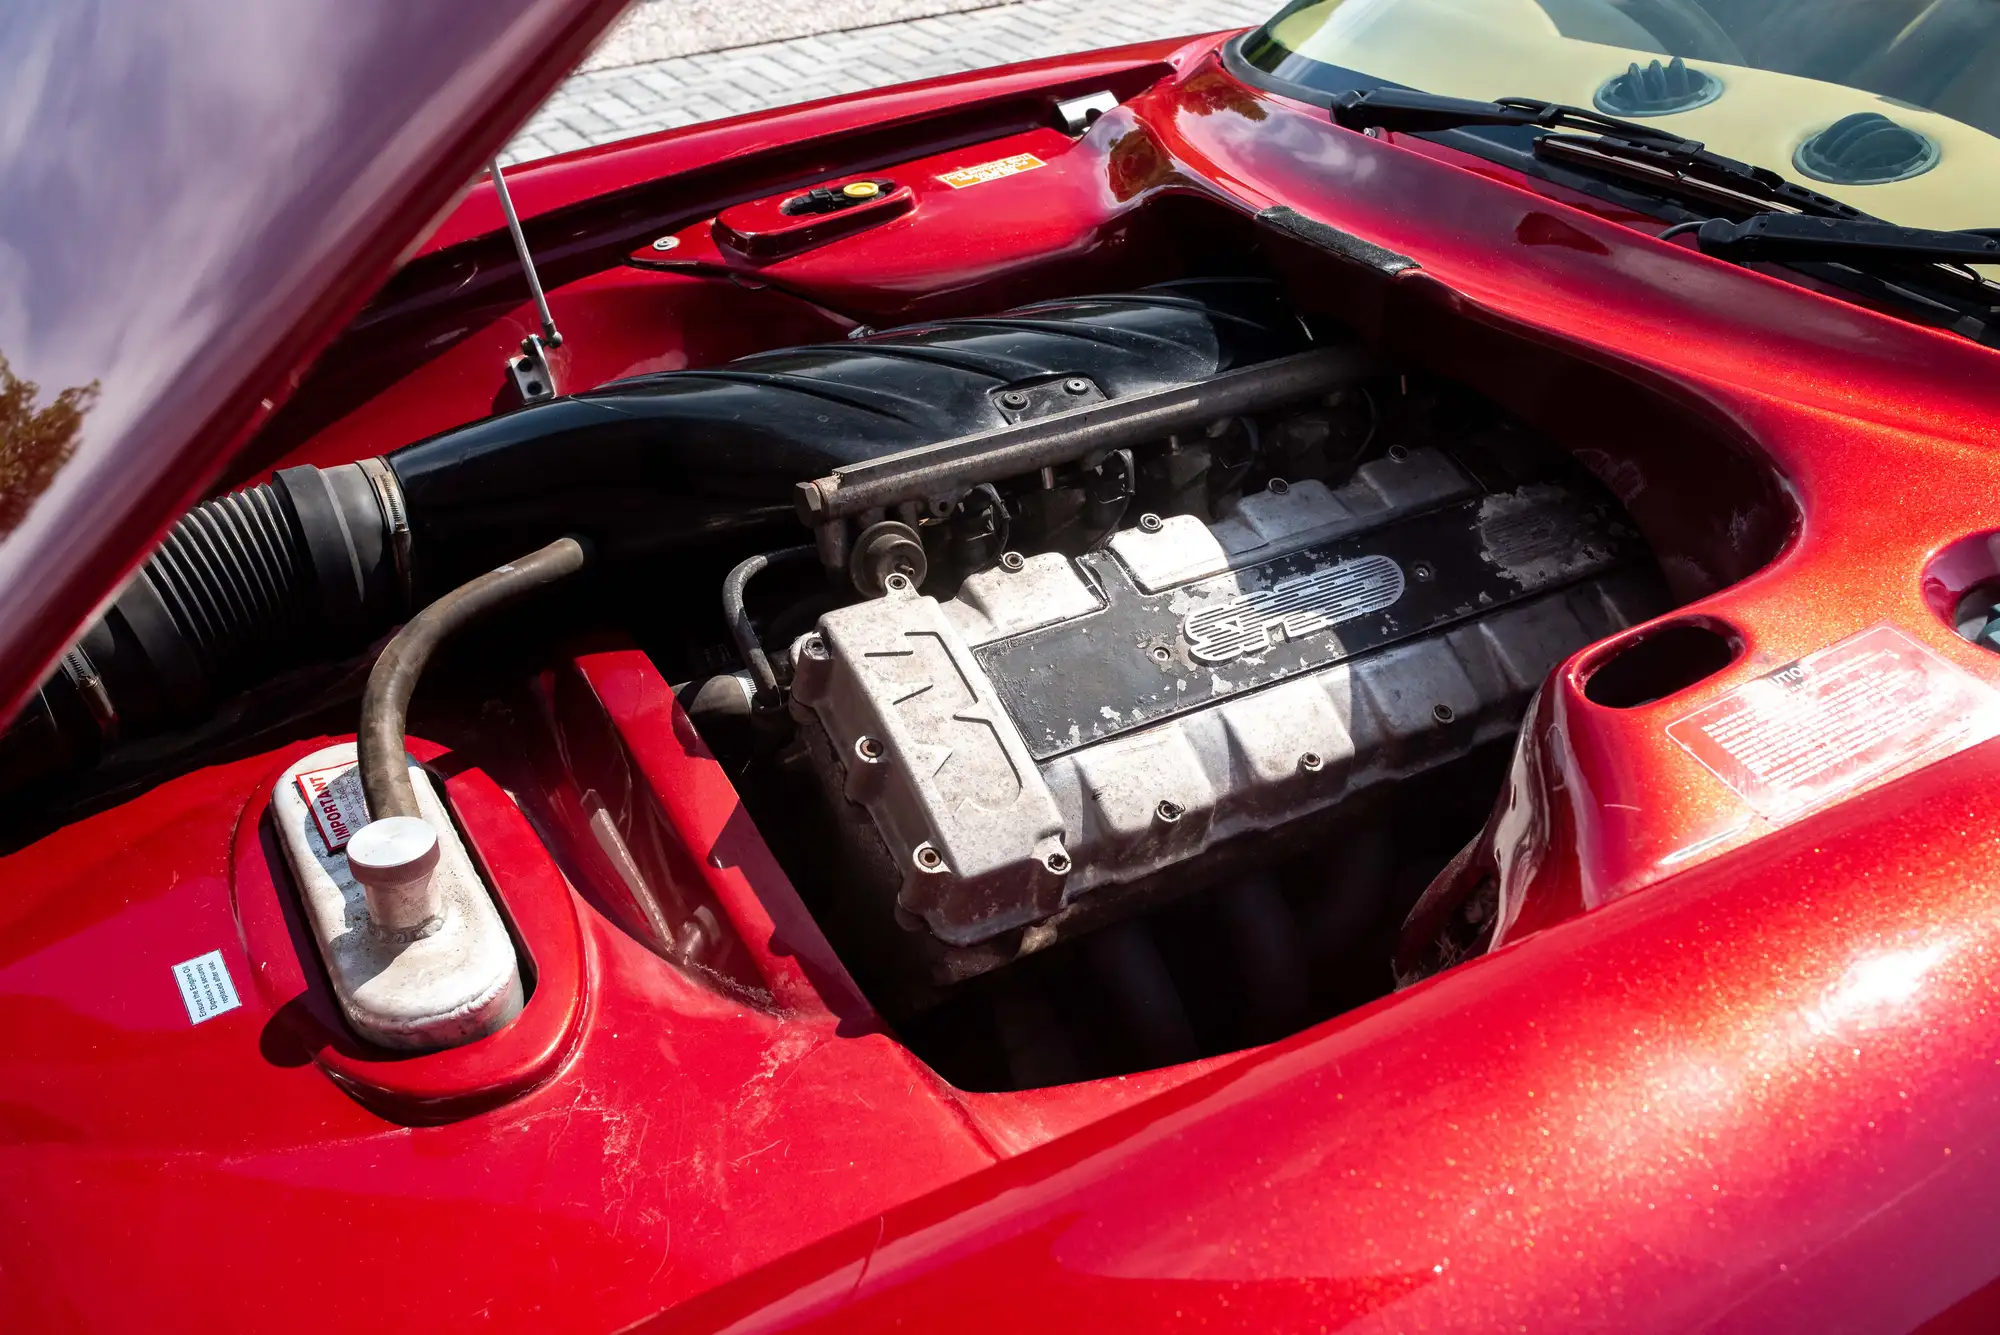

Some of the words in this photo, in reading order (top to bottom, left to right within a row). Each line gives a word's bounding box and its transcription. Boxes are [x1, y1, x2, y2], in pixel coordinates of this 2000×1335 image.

[309, 777, 350, 840] IMPORTANT
[343, 801, 353, 810] OIL
[182, 965, 190, 973] Oil
[195, 963, 208, 984] securely
[211, 971, 220, 982] after
[186, 973, 197, 991] Engine
[192, 990, 200, 999] the
[205, 988, 217, 1010] Dipstick
[215, 982, 228, 1004] replaced
[196, 998, 206, 1017] Ensure
